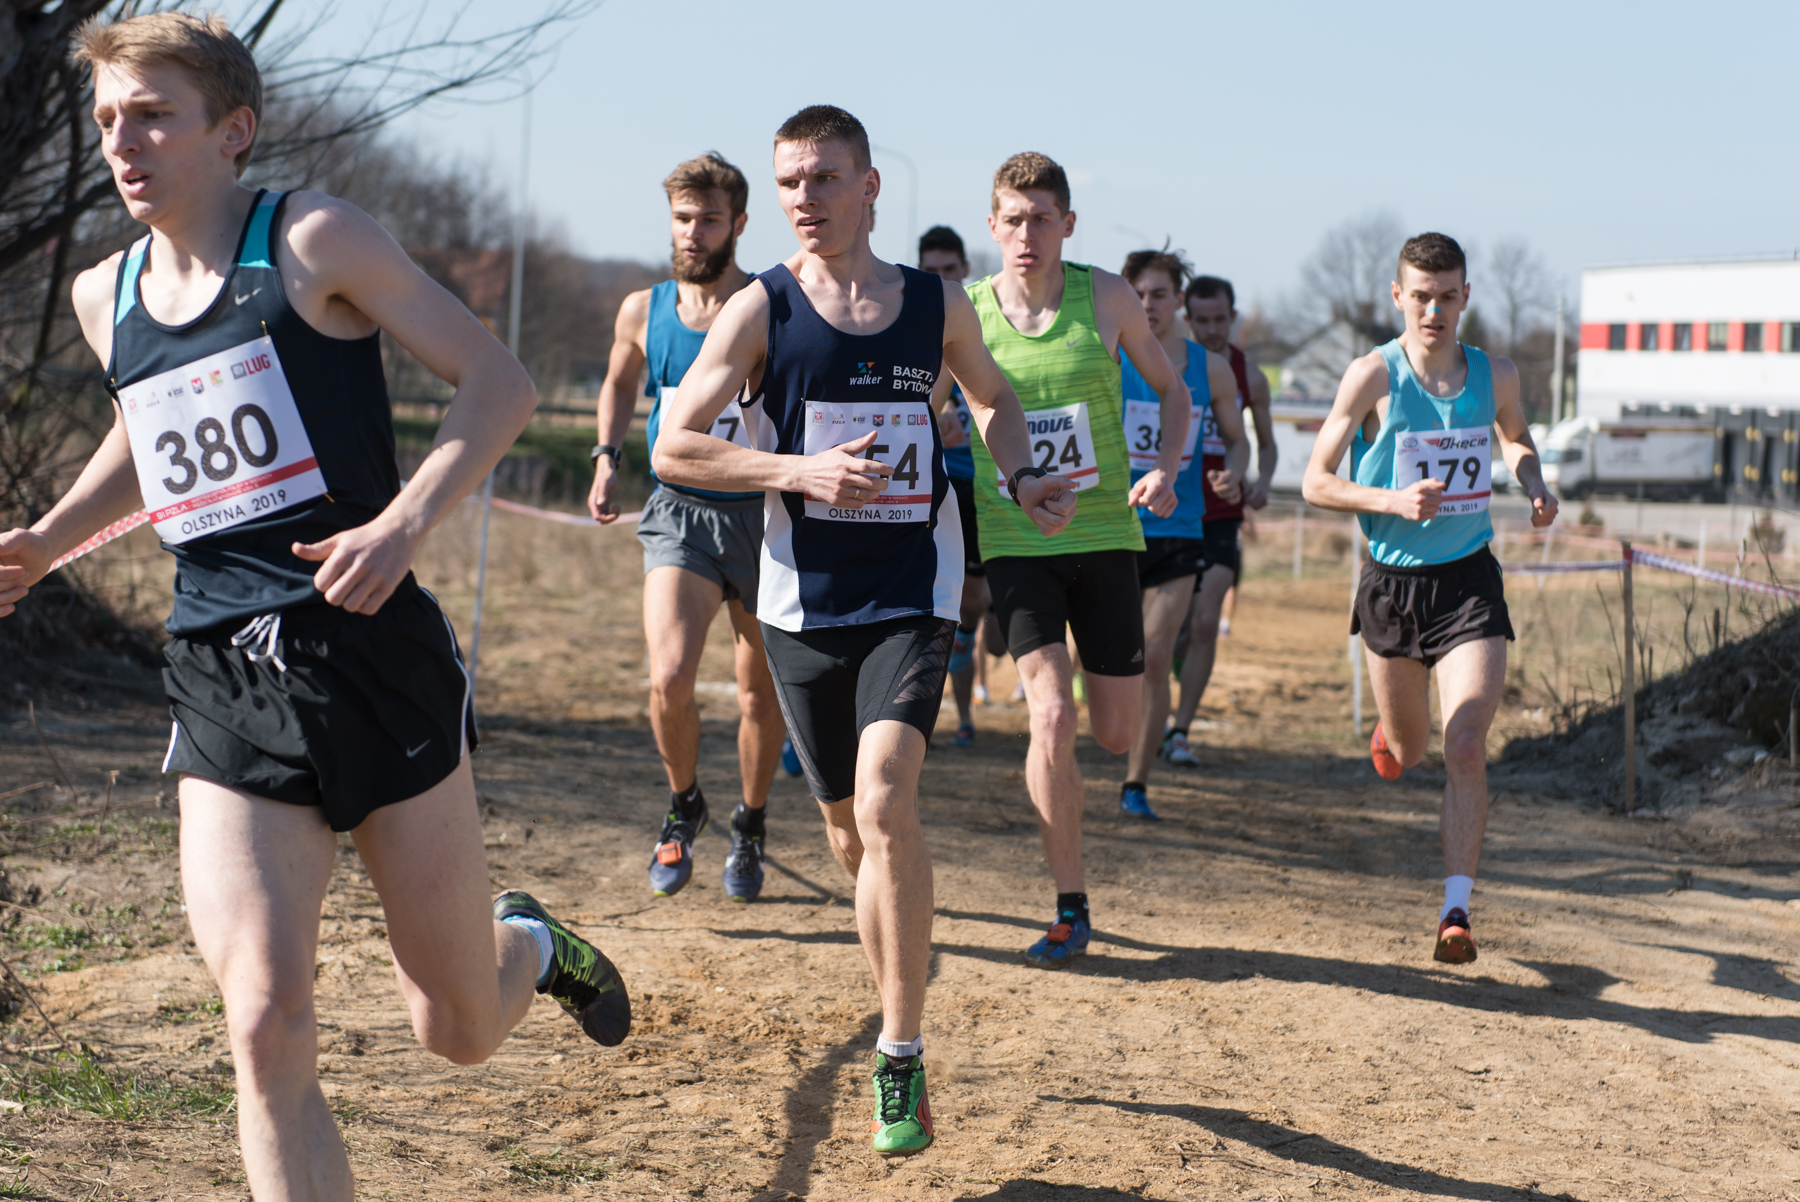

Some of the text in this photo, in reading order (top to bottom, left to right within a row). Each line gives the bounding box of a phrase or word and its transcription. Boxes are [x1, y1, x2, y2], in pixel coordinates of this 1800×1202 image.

[245, 354, 271, 375] LUG
[850, 374, 882, 386] walker
[917, 414, 928, 426] LUG
[155, 403, 279, 495] 380
[1415, 456, 1481, 493] 179
[182, 505, 246, 535] OLSZYNA
[252, 489, 286, 512] 2019
[828, 508, 913, 520] OLSZYNA 2019
[1461, 502, 1478, 512] 2019
